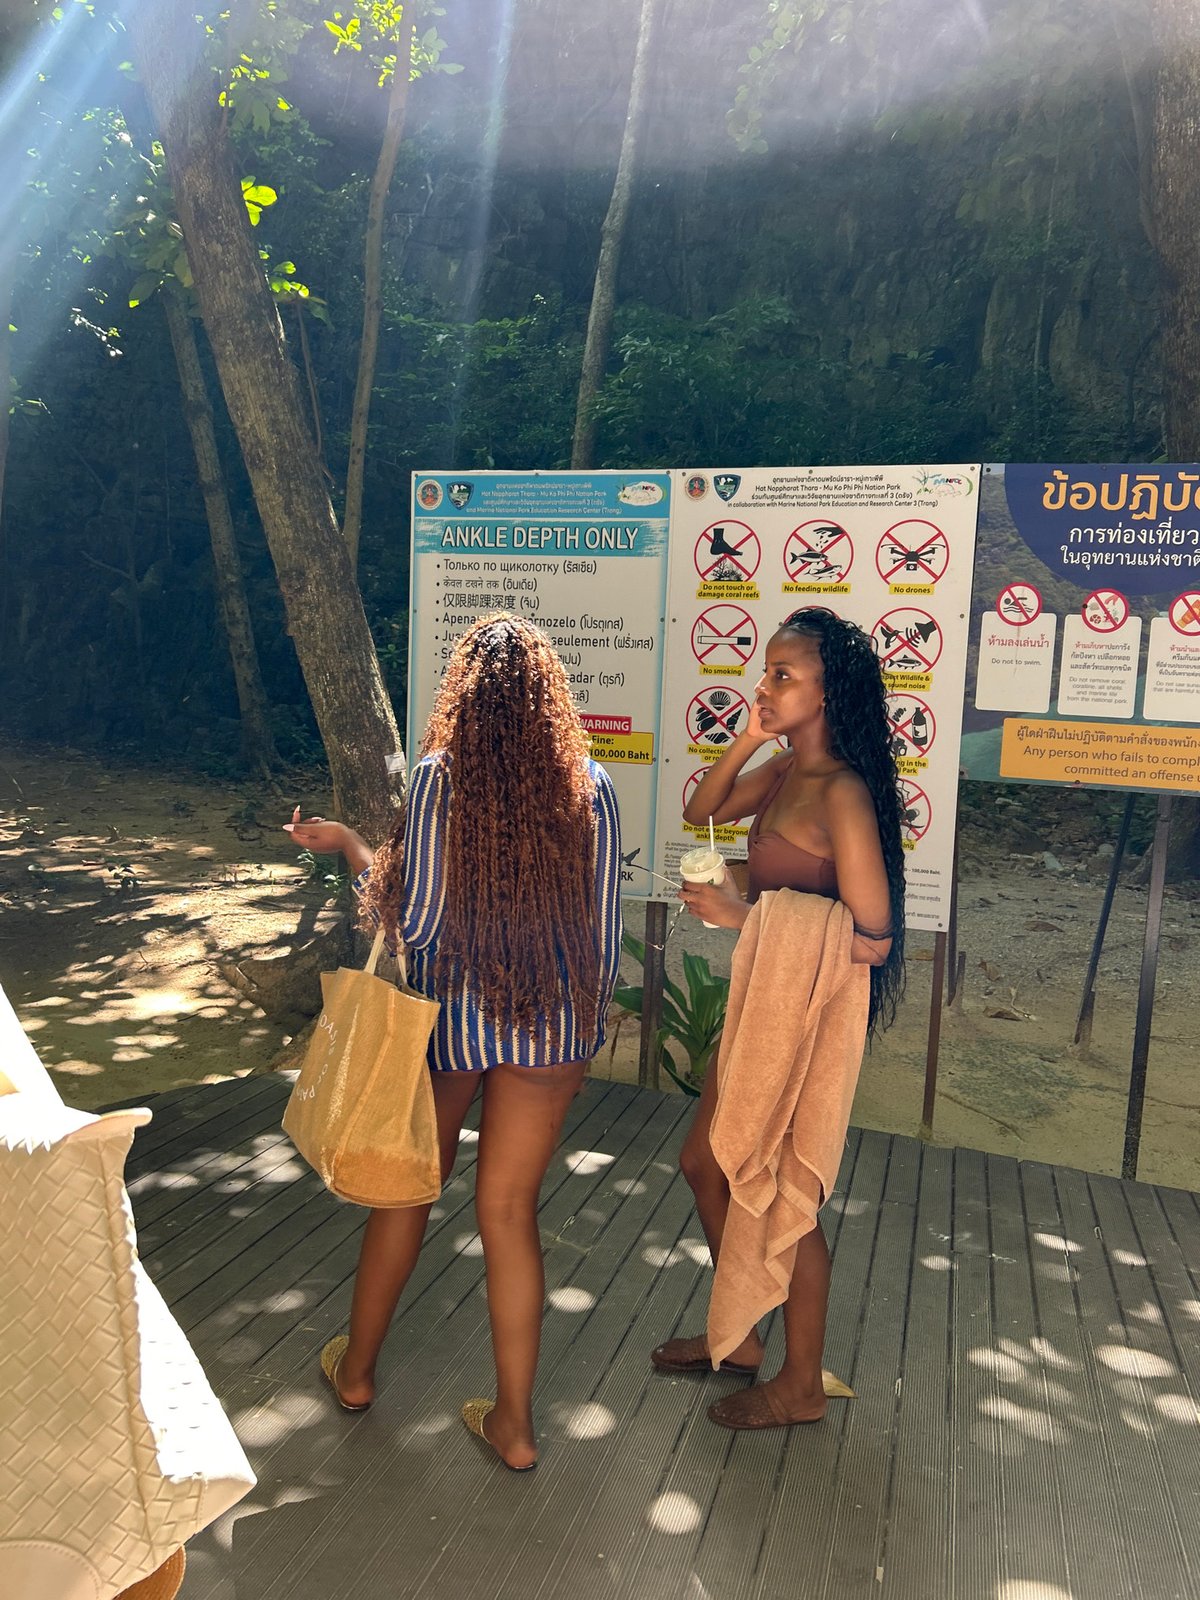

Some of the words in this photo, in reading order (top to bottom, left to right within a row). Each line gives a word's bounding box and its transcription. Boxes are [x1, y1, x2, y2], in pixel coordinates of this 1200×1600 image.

[918, 500, 938, 508] (Trang)
[1069, 516, 1200, 545] การท่องเที่ยว
[441, 526, 508, 548] ANKLE
[513, 526, 580, 549] DEPTH
[585, 527, 638, 550] ONLY
[444, 559, 480, 571] Только
[484, 562, 496, 572] по
[500, 562, 559, 574] щиколотку
[443, 576, 462, 588] केवल
[465, 577, 483, 588] टखने
[486, 579, 500, 589] तक
[795, 585, 821, 593] feeding
[906, 586, 930, 594] drones
[443, 593, 516, 610] 仅限脚踝深度
[520, 596, 540, 611] (จีน)
[443, 612, 476, 626] Apena
[552, 635, 610, 648] seulement
[988, 633, 1050, 648] ห้ามลงเล่นน้ำ
[568, 672, 595, 684] adar
[714, 668, 742, 676] smoking
[581, 718, 630, 731] WARNING
[592, 735, 614, 744] Fine:
[590, 748, 626, 758] 100,000
[628, 750, 650, 760] Baht
[1024, 746, 1046, 758] Any
[1048, 748, 1088, 760] person
[1092, 748, 1118, 761] who
[1120, 750, 1144, 764] fails
[1147, 753, 1159, 764] to
[1162, 756, 1200, 768] compl
[914, 760, 926, 768] the
[1064, 764, 1128, 778] committed
[1132, 770, 1146, 778] an
[1150, 769, 1194, 782] offense
[706, 826, 722, 834] eter
[724, 828, 748, 836] beyond
[621, 871, 634, 882] RK
